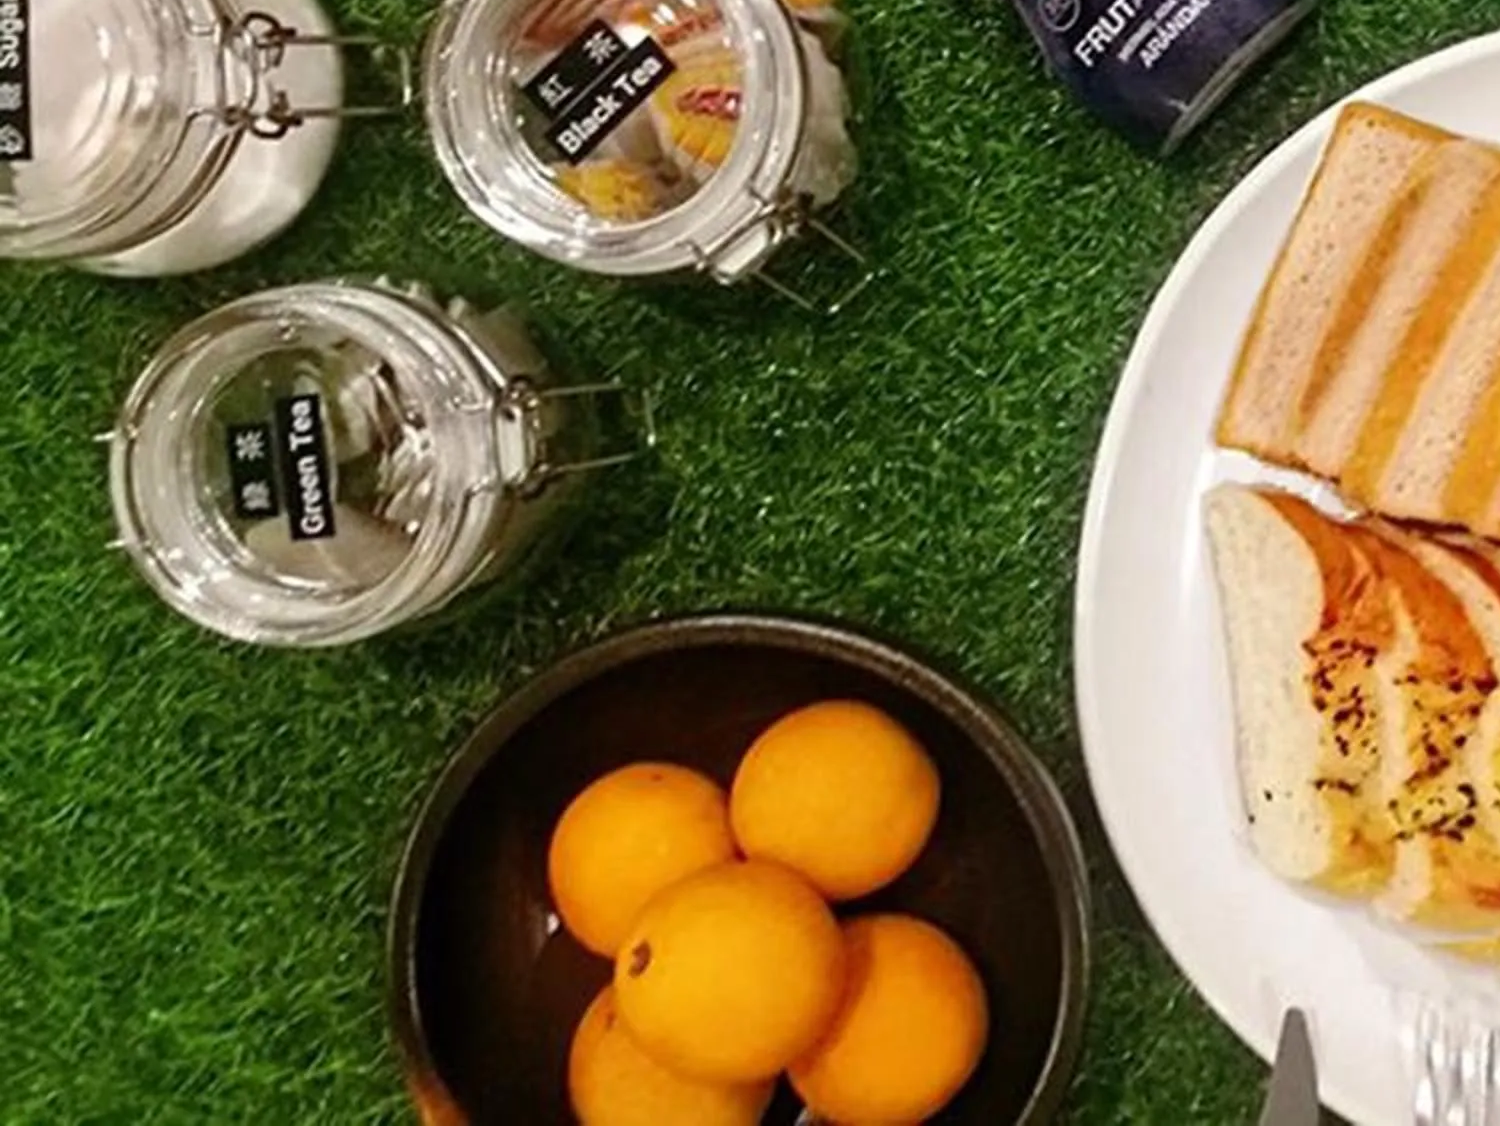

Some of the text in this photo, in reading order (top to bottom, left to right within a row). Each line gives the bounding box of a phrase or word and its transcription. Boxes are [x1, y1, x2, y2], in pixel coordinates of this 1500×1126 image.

[556, 56, 663, 154] Black Tea
[288, 399, 326, 534] Green Tea
